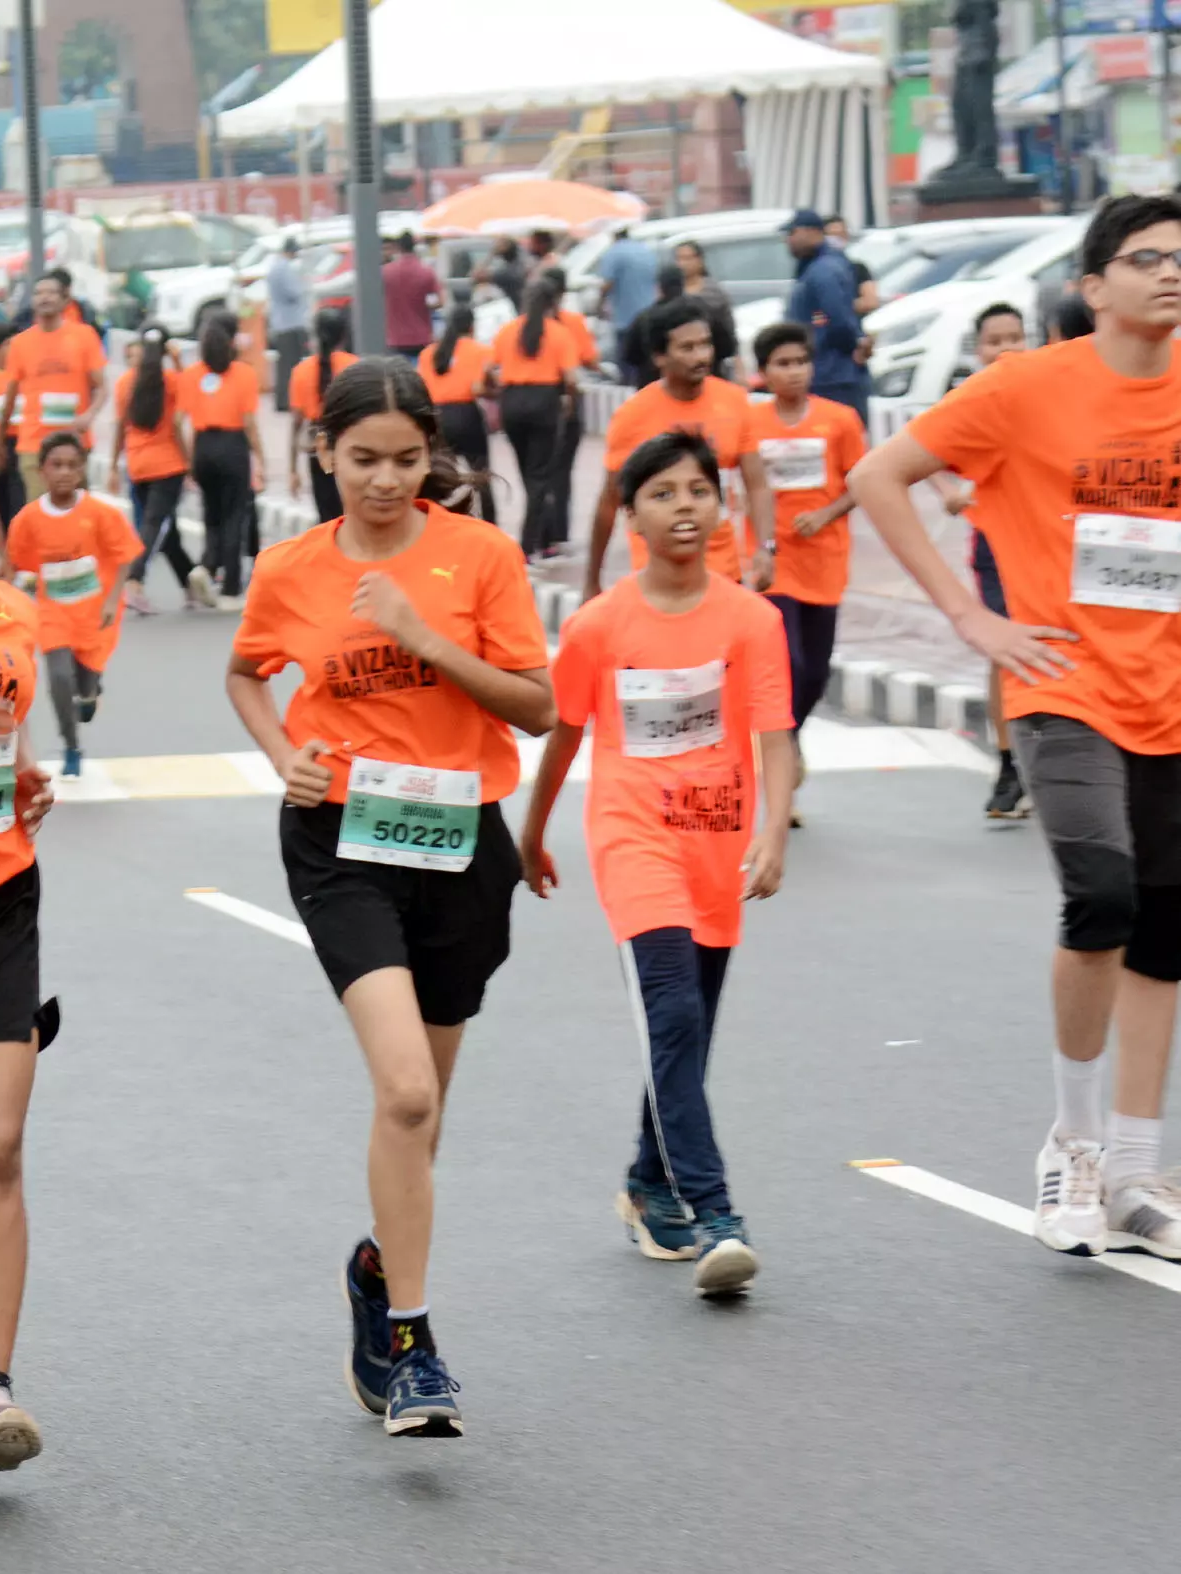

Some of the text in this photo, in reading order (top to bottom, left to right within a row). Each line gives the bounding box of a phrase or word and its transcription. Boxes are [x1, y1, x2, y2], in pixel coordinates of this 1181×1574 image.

[1097, 458, 1164, 486] VIZAG
[343, 644, 412, 677] VIZAG
[327, 670, 417, 699] MARATHON
[373, 820, 463, 849] 50220
